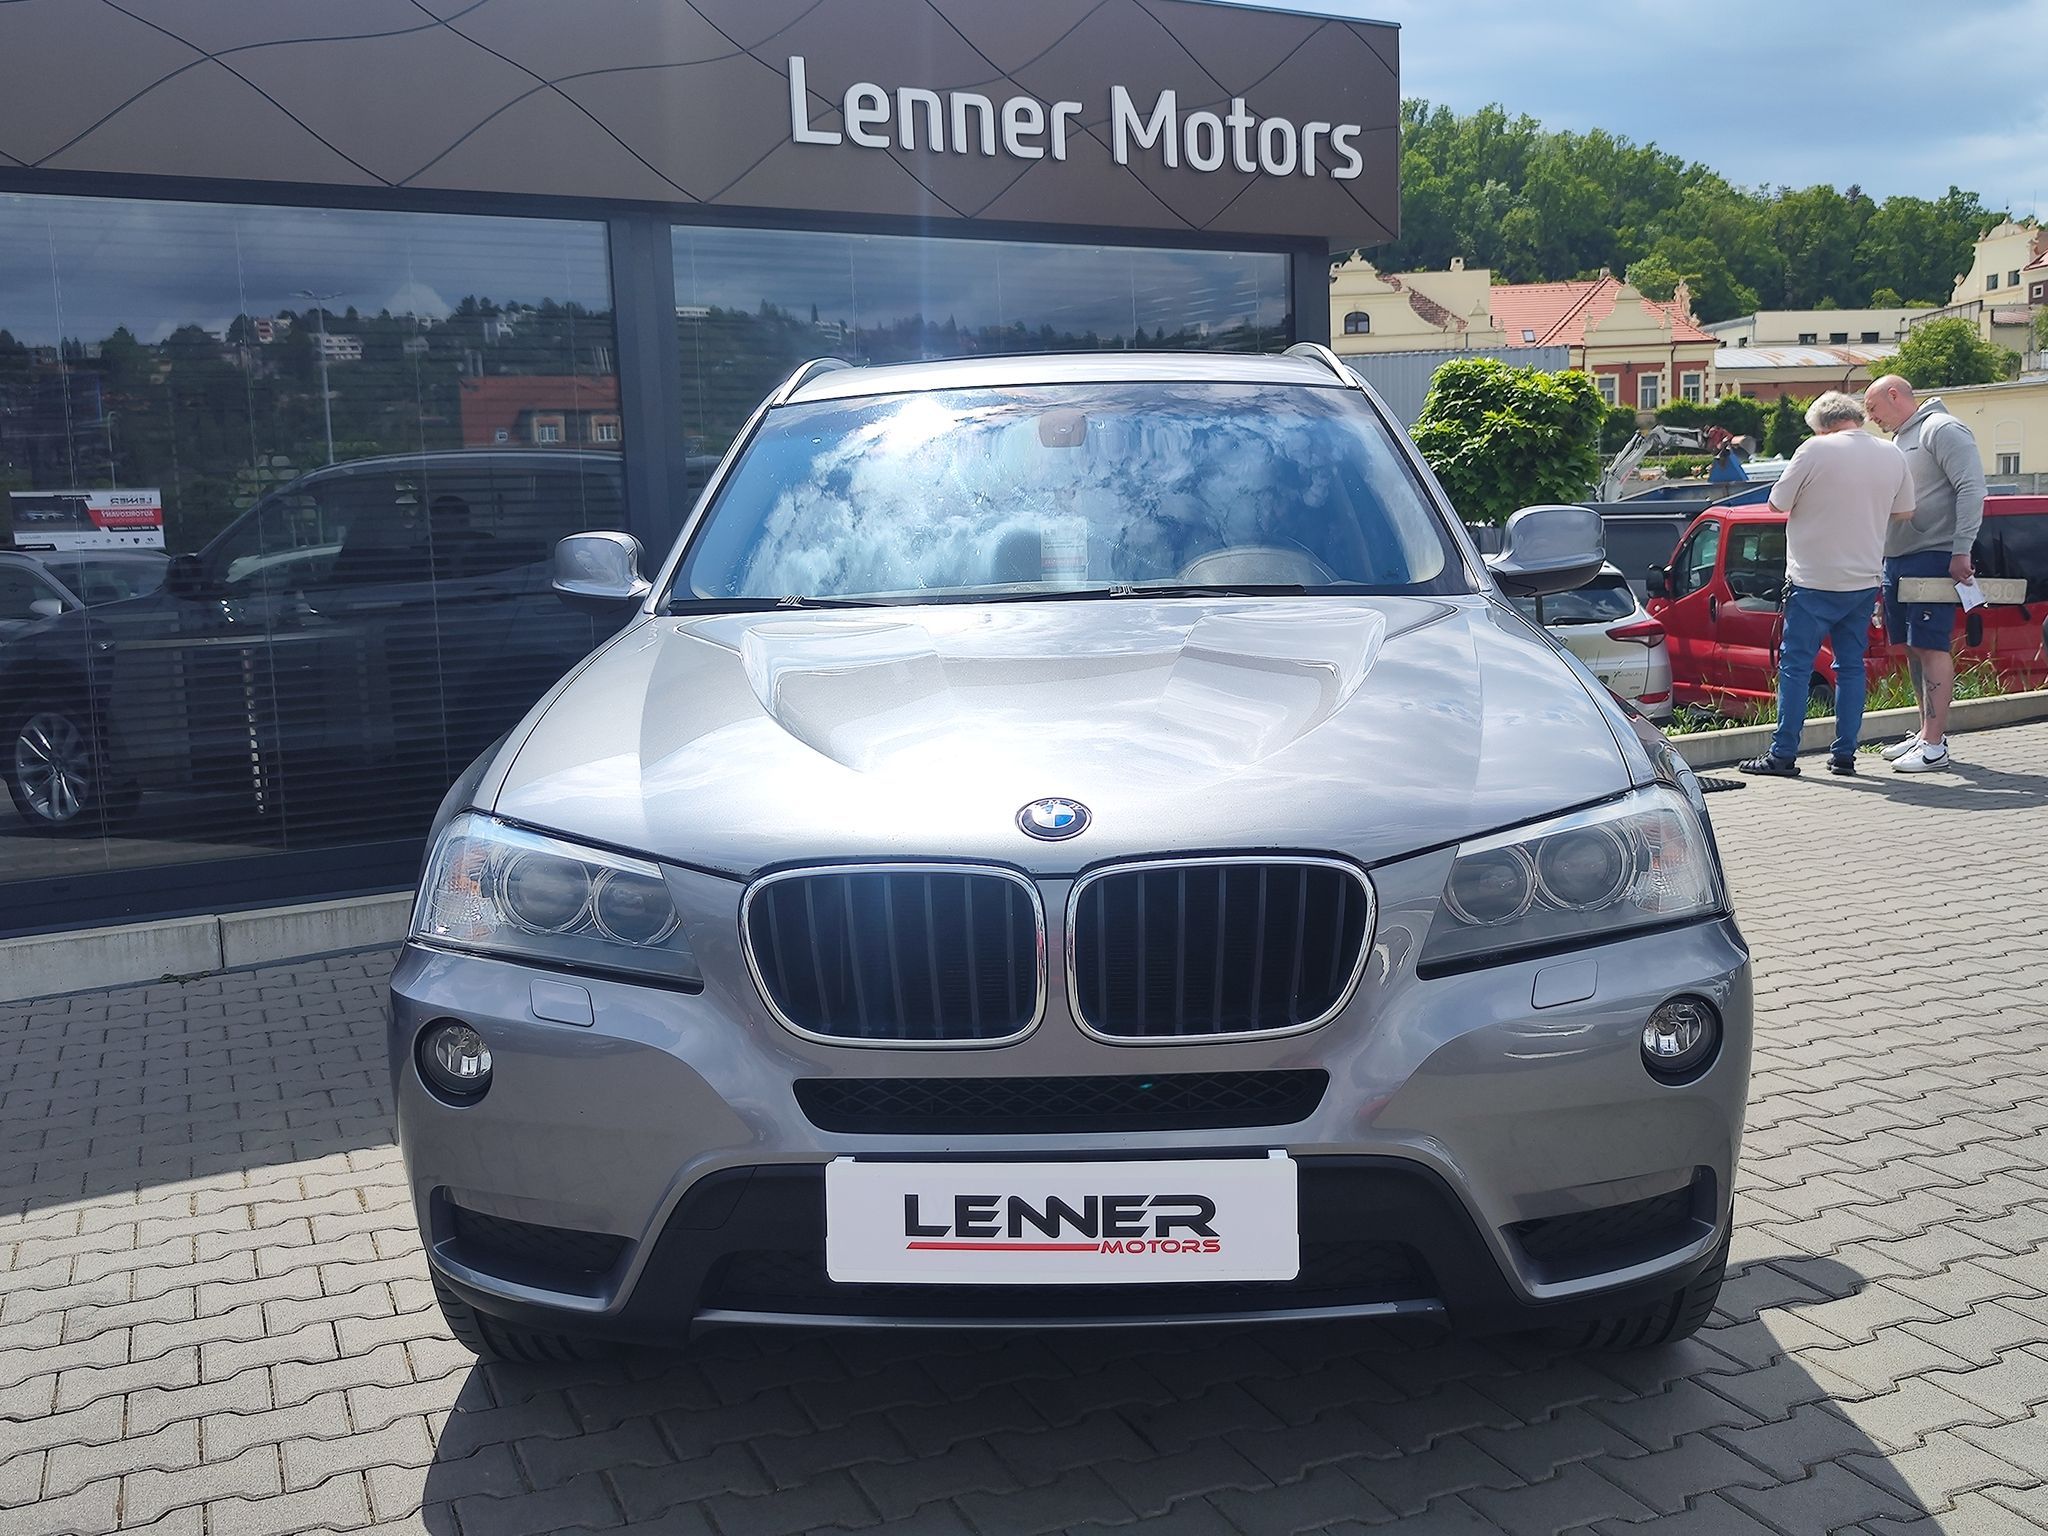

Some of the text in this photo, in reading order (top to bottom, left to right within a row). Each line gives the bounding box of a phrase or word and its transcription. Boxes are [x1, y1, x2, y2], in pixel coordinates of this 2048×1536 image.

[788, 56, 1364, 179] Lenner Motors
[904, 1194, 1220, 1238] LENNER
[1100, 1239, 1221, 1254] MOTORS
